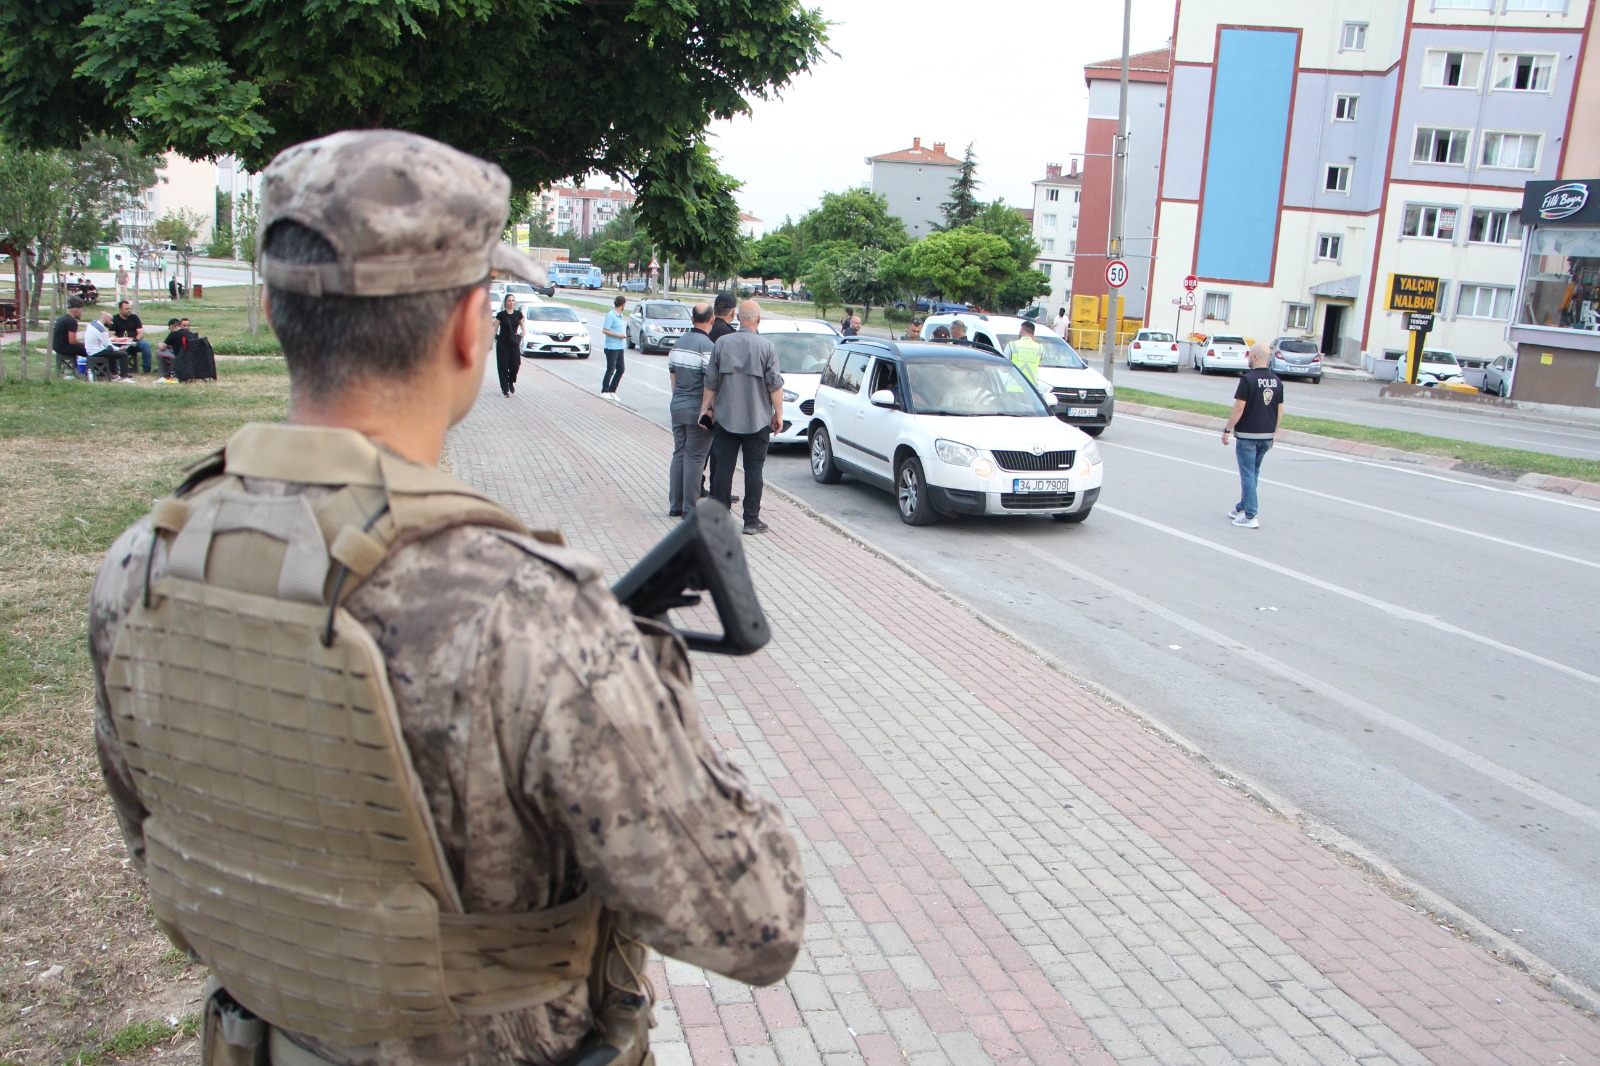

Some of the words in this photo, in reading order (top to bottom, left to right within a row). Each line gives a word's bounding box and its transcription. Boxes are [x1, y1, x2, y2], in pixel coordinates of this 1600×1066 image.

[1560, 194, 1582, 208] Boya
[1110, 268, 1124, 281] 50
[1400, 278, 1435, 294] YALÇIN
[1394, 295, 1434, 309] NALBUR
[1020, 481, 1030, 490] 34
[1032, 481, 1044, 490] JD
[1046, 480, 1067, 490] 7900
